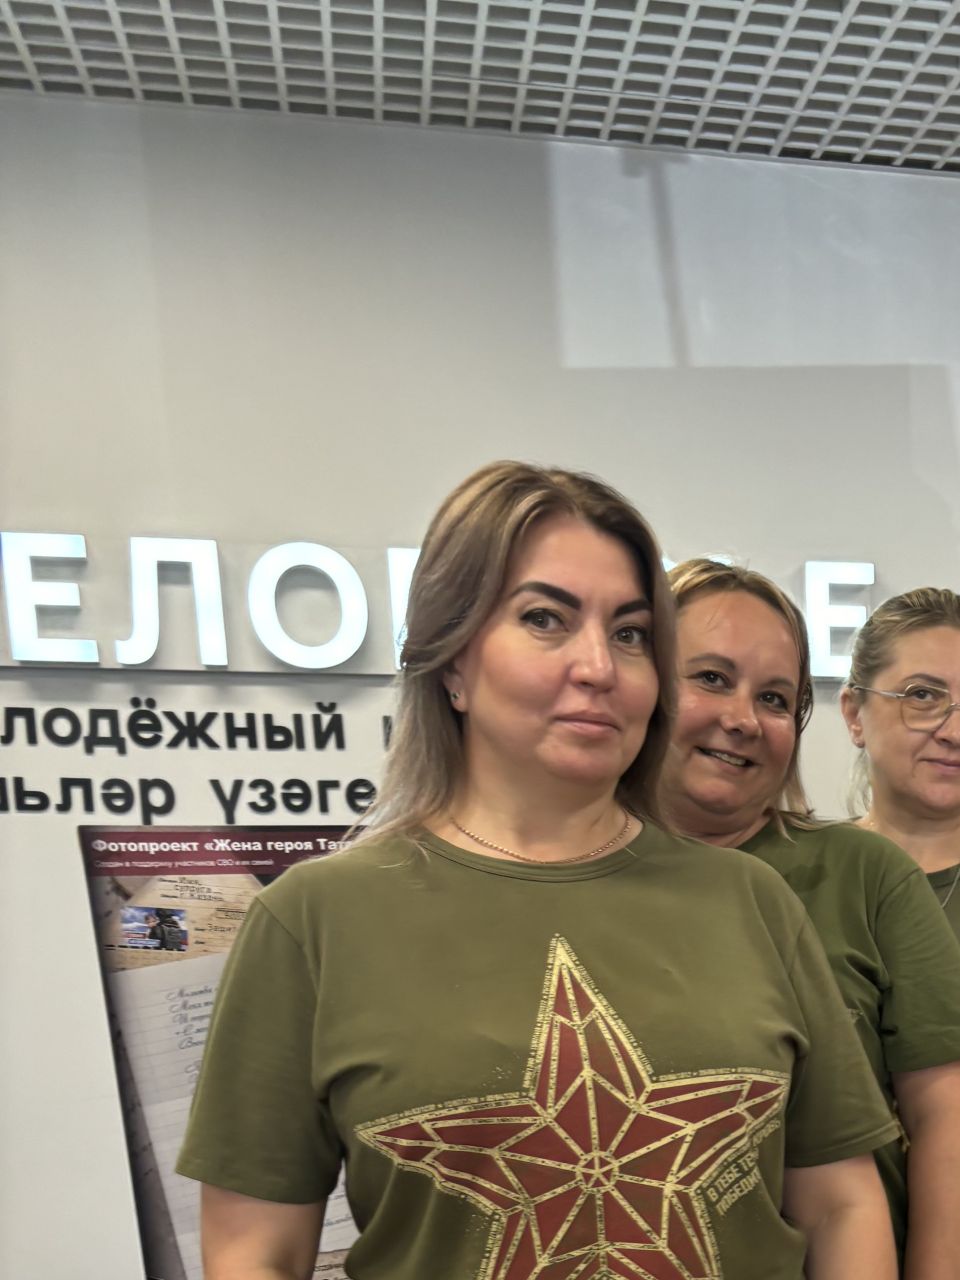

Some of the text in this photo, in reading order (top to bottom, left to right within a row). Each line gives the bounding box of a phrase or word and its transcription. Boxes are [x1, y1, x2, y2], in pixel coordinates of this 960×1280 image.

[209, 777, 377, 824] үзәге
[91, 838, 199, 855] Фотопроект
[204, 838, 262, 851] «Жена
[266, 840, 313, 854] героя
